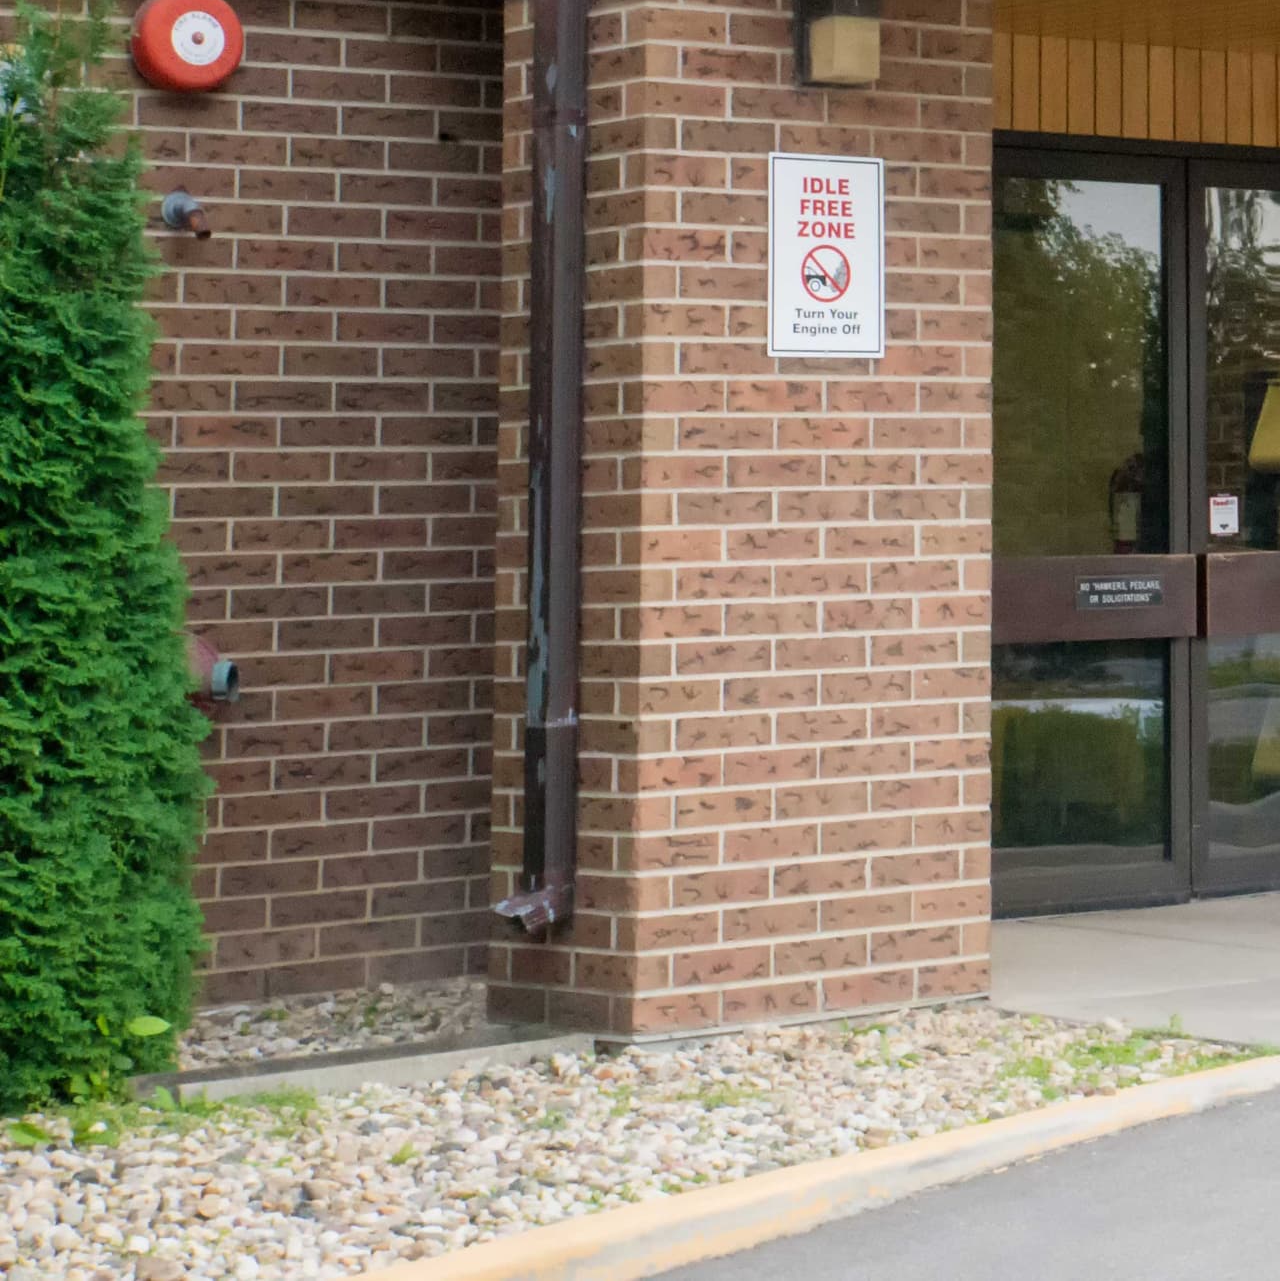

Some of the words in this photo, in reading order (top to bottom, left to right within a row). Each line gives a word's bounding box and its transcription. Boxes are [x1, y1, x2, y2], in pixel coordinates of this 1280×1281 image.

[802, 177, 850, 196] IDLE
[800, 199, 853, 217] FREE
[797, 221, 856, 239] ZONE
[795, 308, 825, 319] Turn
[829, 309, 859, 320] Your
[792, 323, 837, 337] Engine
[842, 324, 862, 335] Off
[1080, 582, 1090, 591] NO
[1089, 594, 1099, 603] OR
